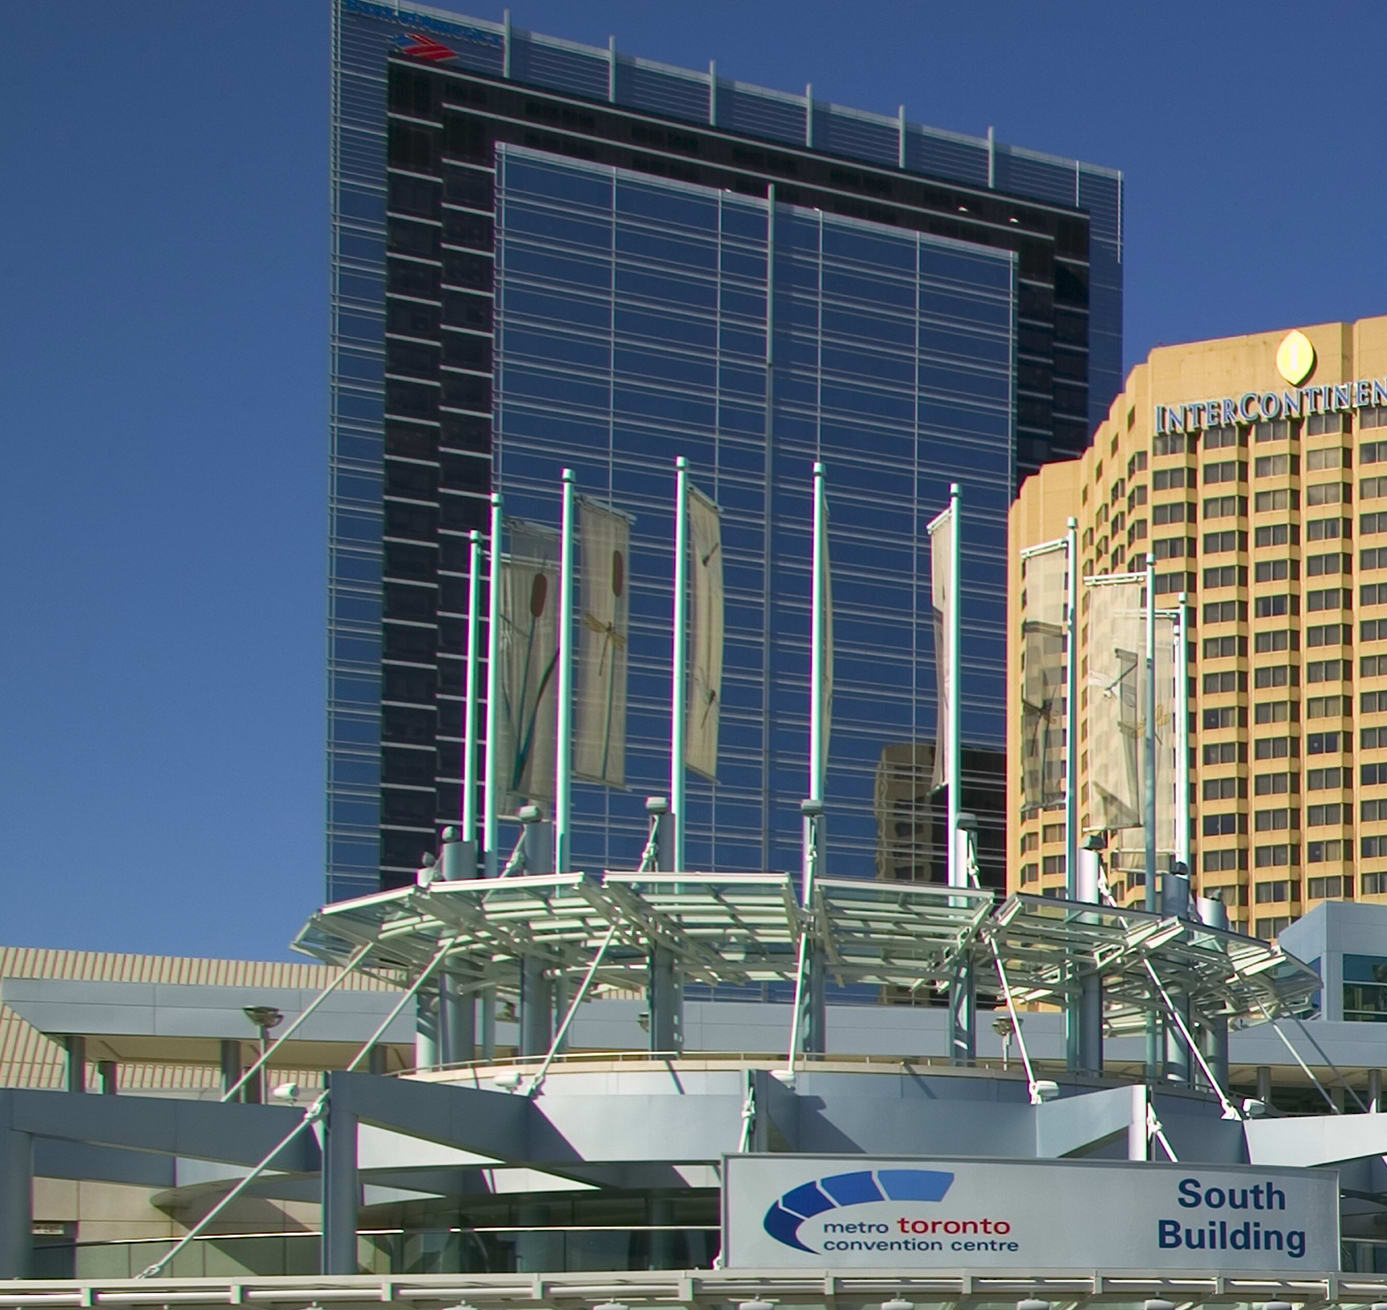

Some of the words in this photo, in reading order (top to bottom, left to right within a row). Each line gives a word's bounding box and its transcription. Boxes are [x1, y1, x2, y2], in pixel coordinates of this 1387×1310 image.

[1178, 1178, 1286, 1210] South
[823, 1220, 889, 1234] metro
[897, 1217, 1011, 1235] toronto
[823, 1238, 943, 1252] convention
[950, 1238, 1020, 1252] centre
[1158, 1219, 1306, 1259] Building
